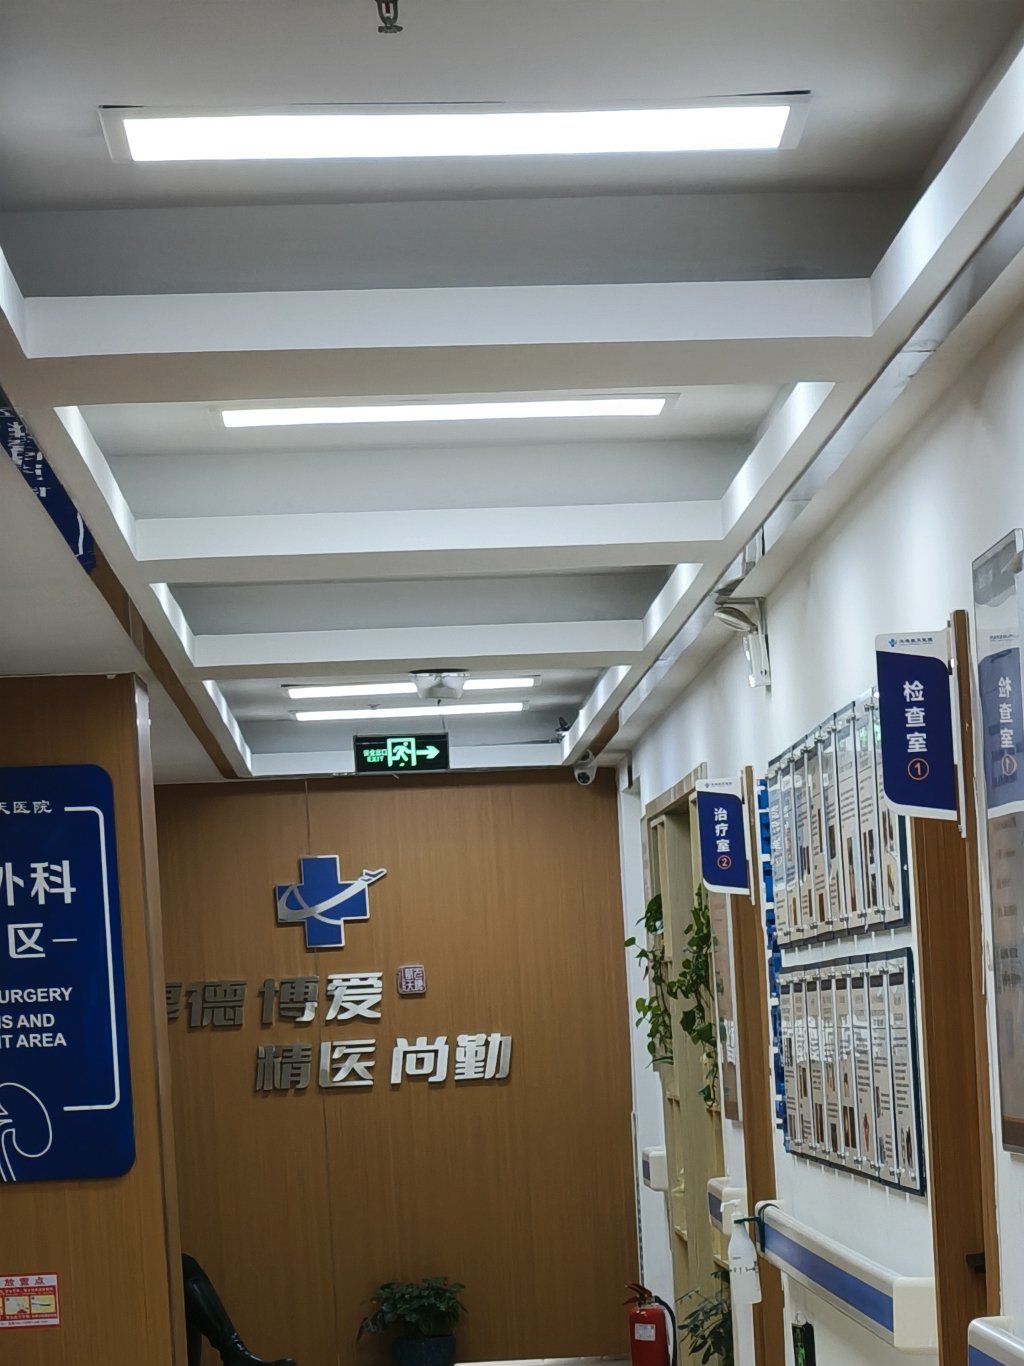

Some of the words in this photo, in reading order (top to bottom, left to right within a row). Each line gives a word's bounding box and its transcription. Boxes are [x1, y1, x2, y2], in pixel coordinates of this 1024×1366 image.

[16, 1013, 55, 1029] AND
[16, 1032, 67, 1048] AREA
[255, 1032, 513, 1092] 精医尚勤
